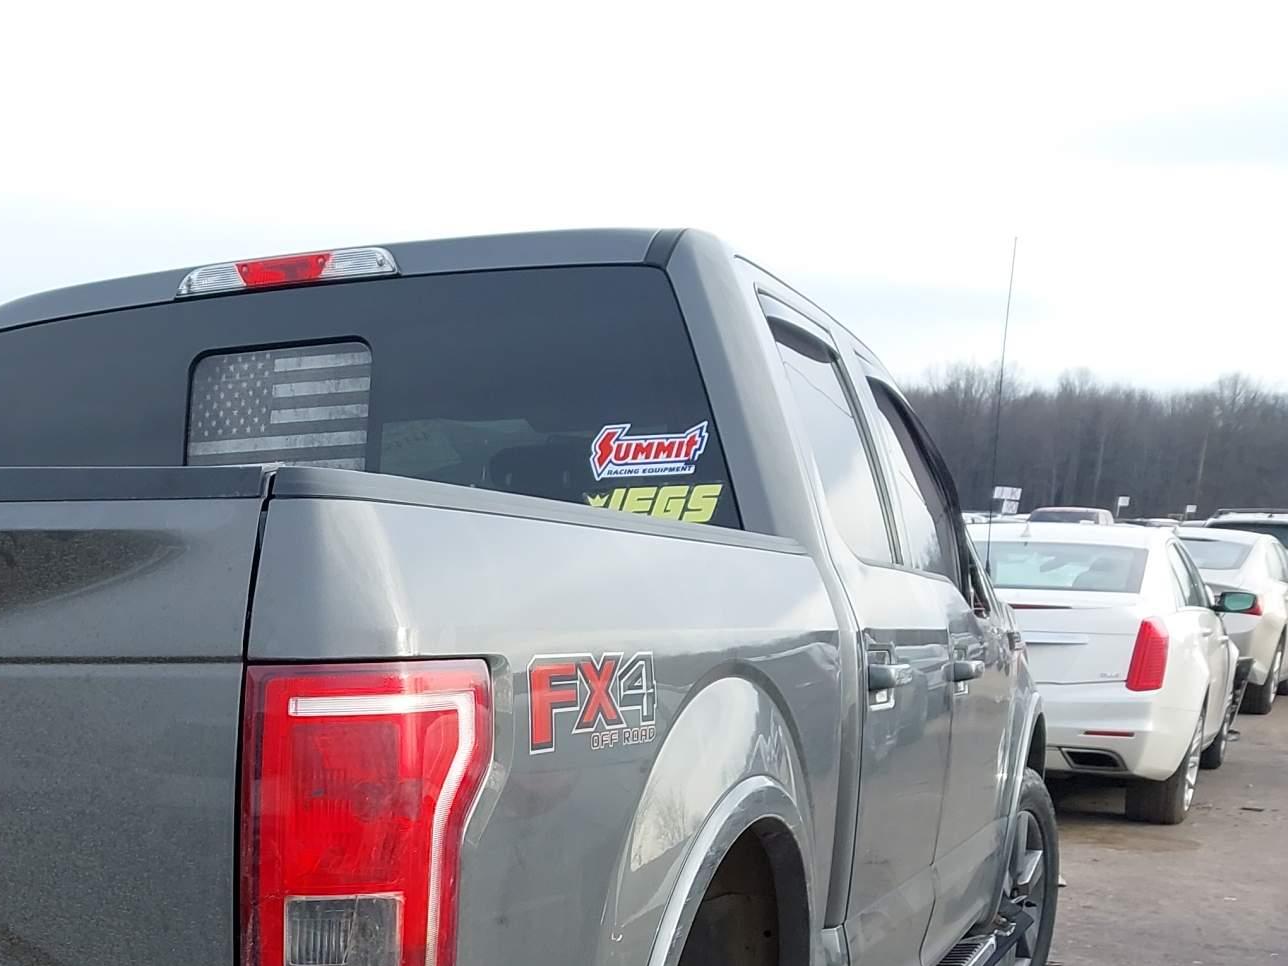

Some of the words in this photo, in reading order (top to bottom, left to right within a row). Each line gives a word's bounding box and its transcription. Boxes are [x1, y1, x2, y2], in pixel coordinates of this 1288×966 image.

[607, 467, 640, 477] RACING
[642, 465, 693, 475] EQUIPMENT
[527, 651, 657, 755] FX4
[590, 730, 619, 750] OFF
[623, 726, 657, 745] ROAD
